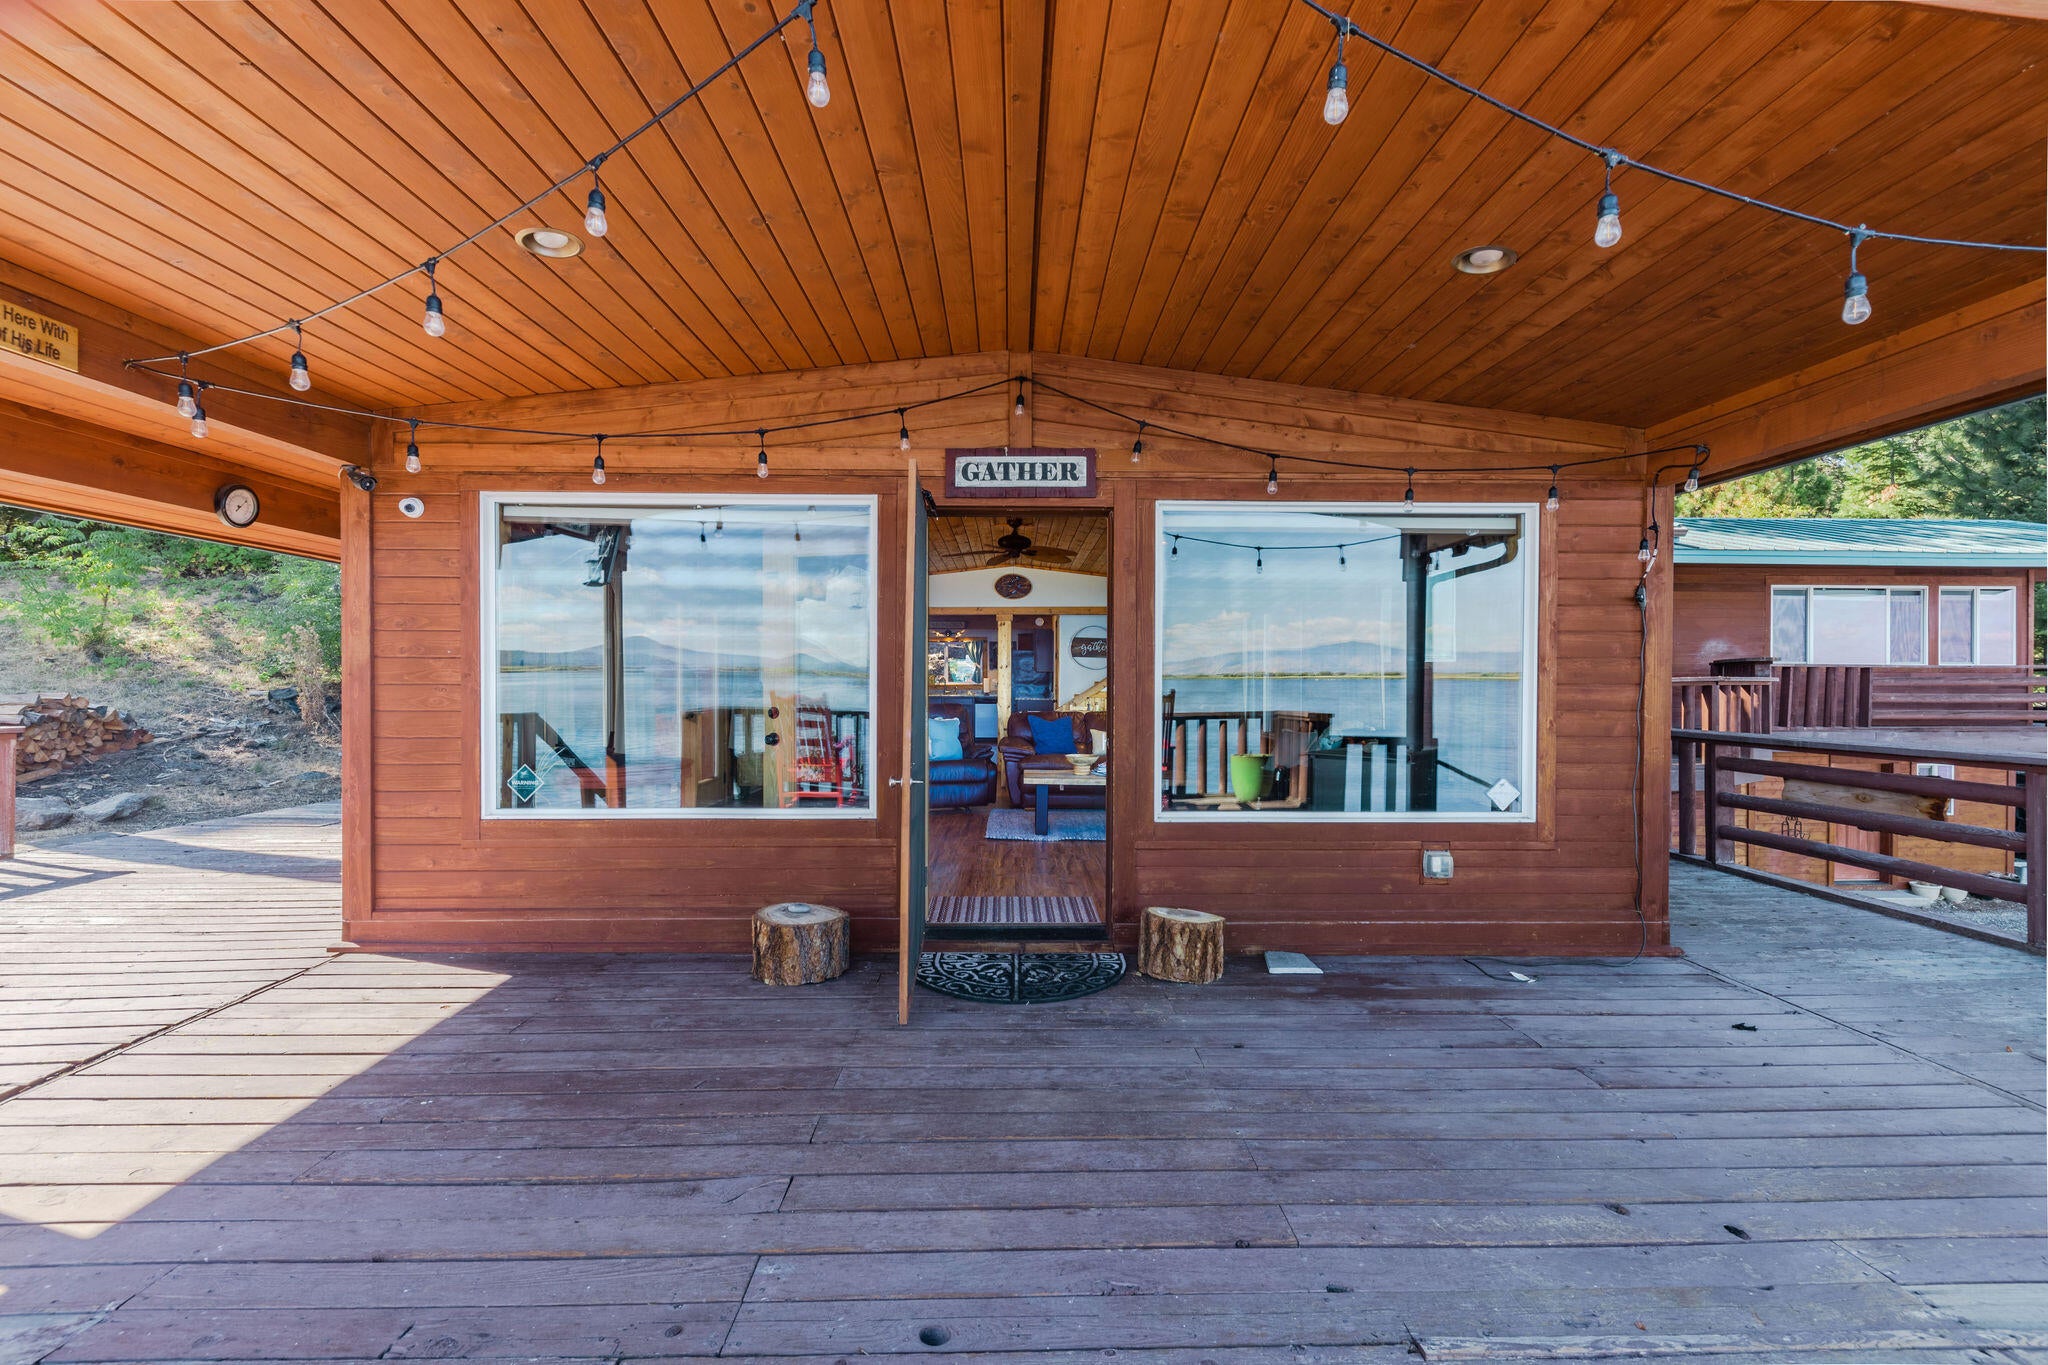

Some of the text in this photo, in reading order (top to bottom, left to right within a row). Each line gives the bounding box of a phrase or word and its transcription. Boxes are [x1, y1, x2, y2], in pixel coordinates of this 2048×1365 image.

[3, 304, 69, 342] Here With
[11, 330, 33, 353] His
[36, 338, 60, 360] Life
[961, 462, 1080, 482] GATHER
[1080, 639, 1107, 656] gathe
